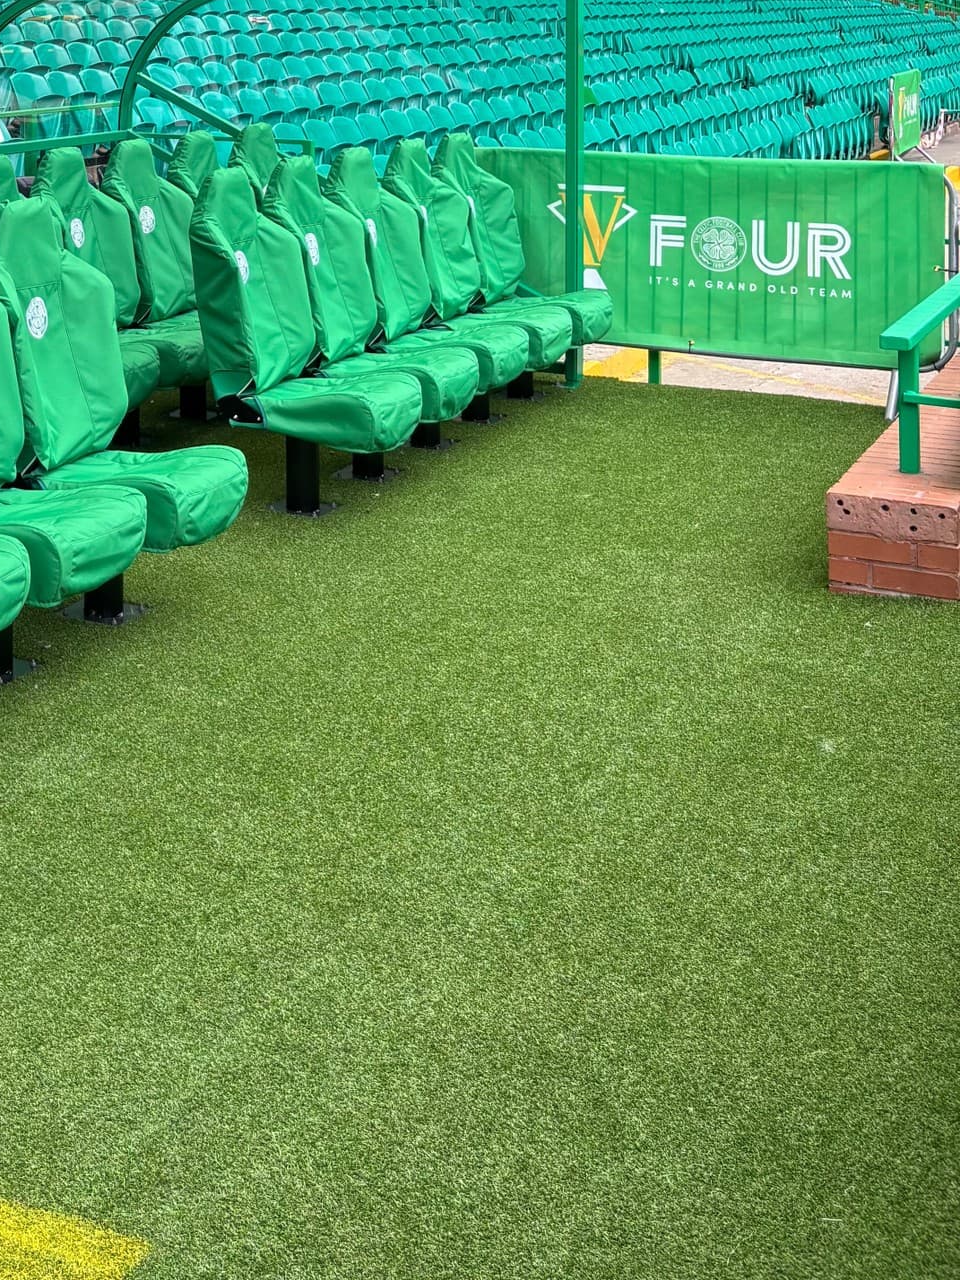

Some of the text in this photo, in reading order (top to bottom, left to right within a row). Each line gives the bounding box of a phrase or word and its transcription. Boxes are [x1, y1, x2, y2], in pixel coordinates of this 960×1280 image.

[648, 275, 853, 299] IT'S A GRAND OLD TEAM
